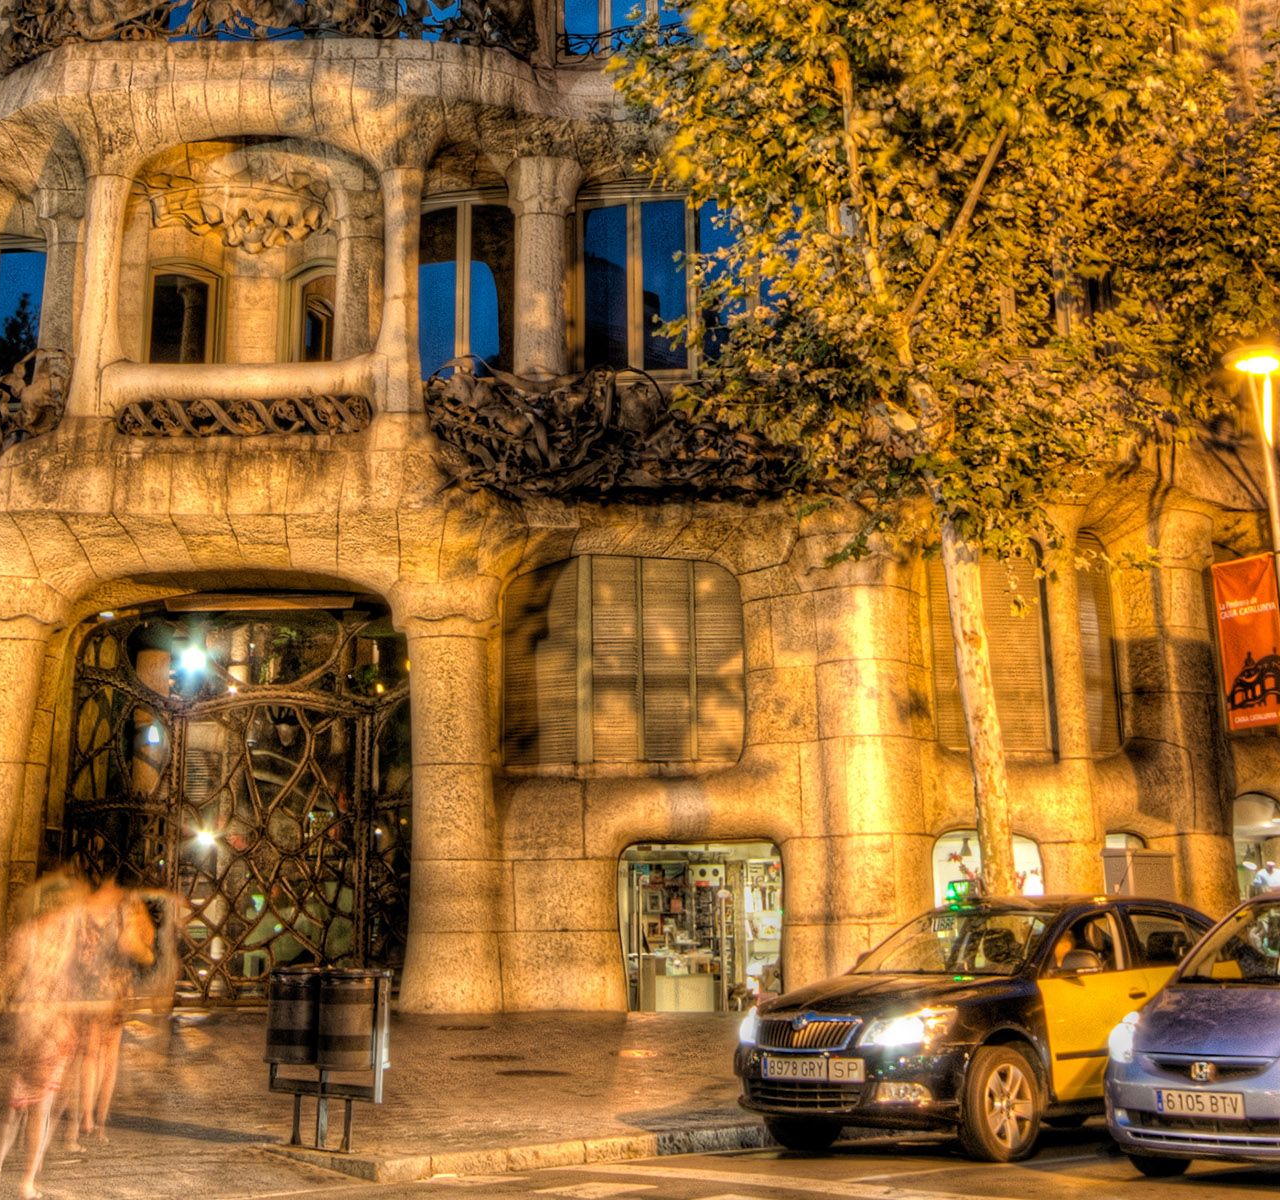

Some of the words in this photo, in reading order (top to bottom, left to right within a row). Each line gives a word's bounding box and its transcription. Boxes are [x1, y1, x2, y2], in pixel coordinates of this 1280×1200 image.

[768, 1060, 799, 1077] 8978
[800, 1061, 824, 1078] GRY
[833, 1061, 858, 1079] SP
[1166, 1092, 1205, 1112] 6105
[1209, 1095, 1238, 1114] BTV
